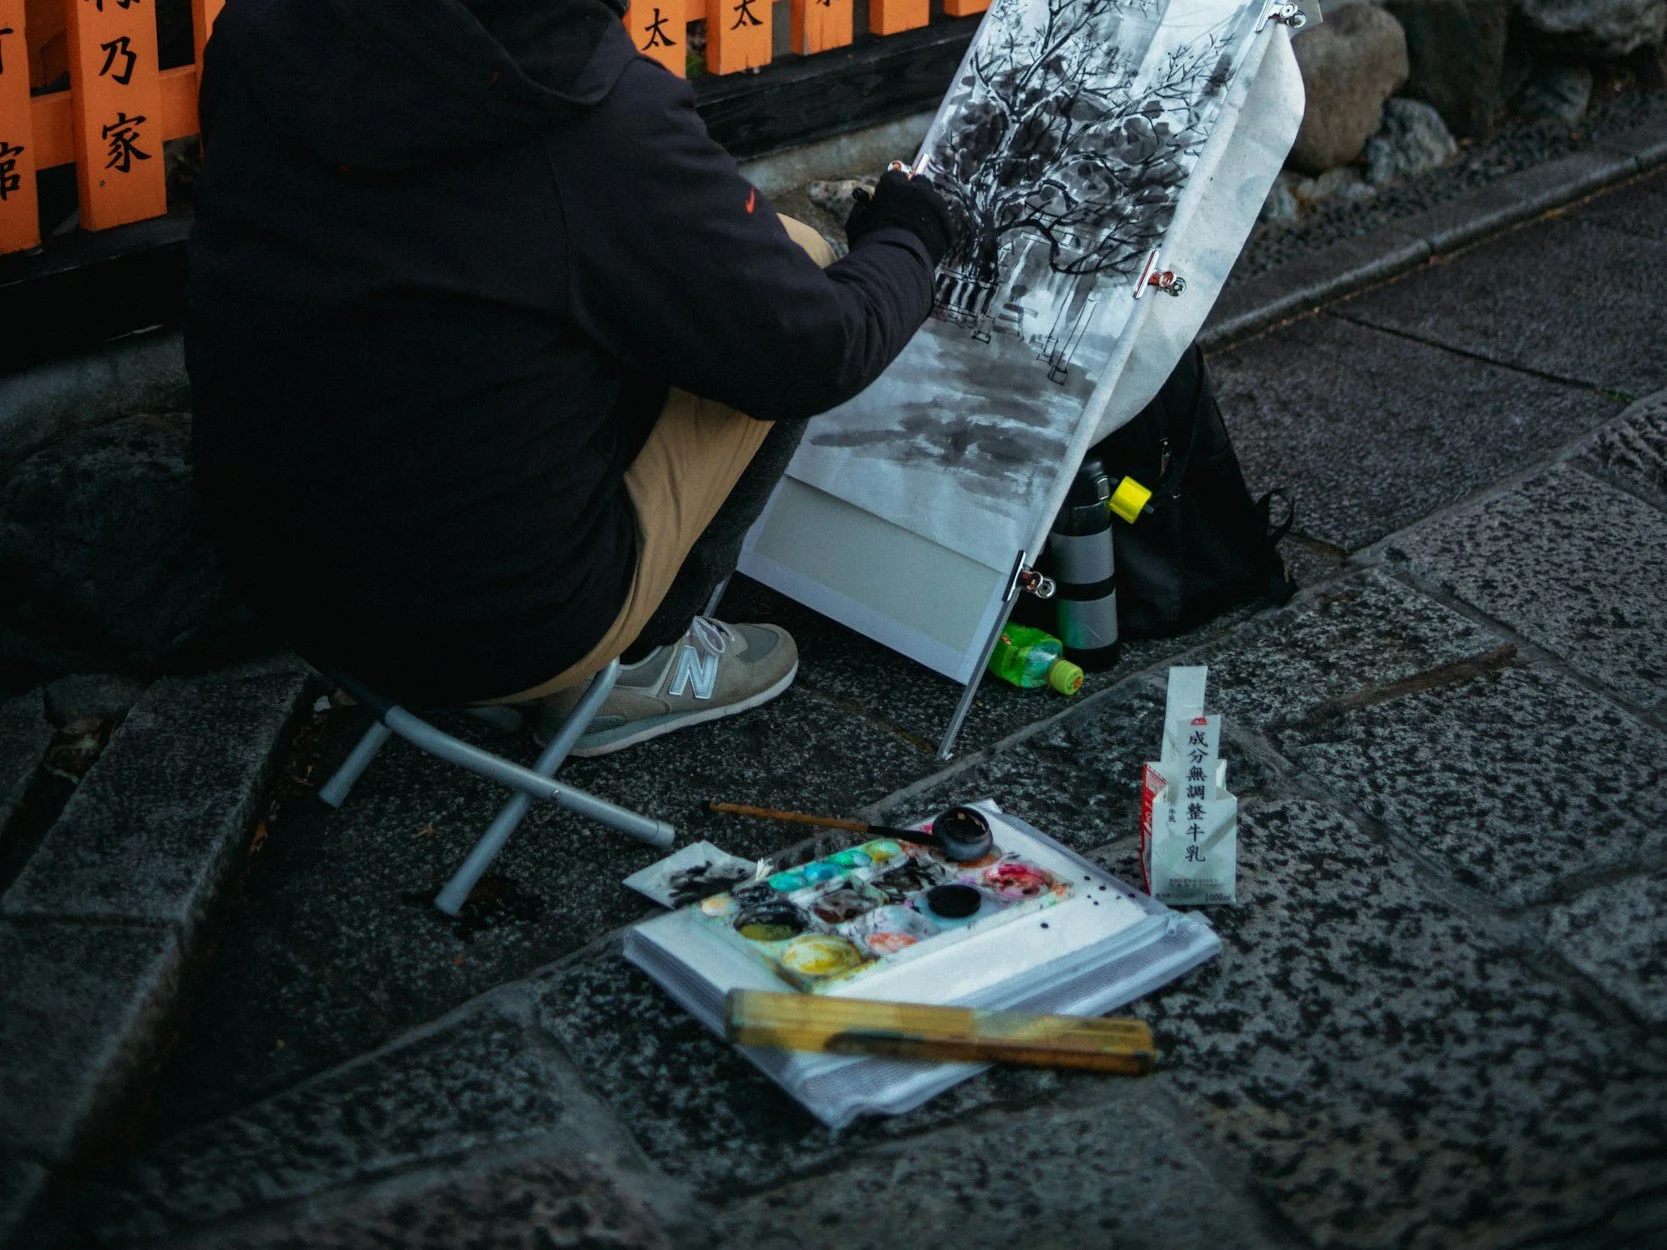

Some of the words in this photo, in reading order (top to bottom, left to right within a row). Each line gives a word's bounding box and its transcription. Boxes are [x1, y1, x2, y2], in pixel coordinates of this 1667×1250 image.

[668, 644, 720, 700] N
[1184, 730, 1209, 863] 成分無調整牛乳
